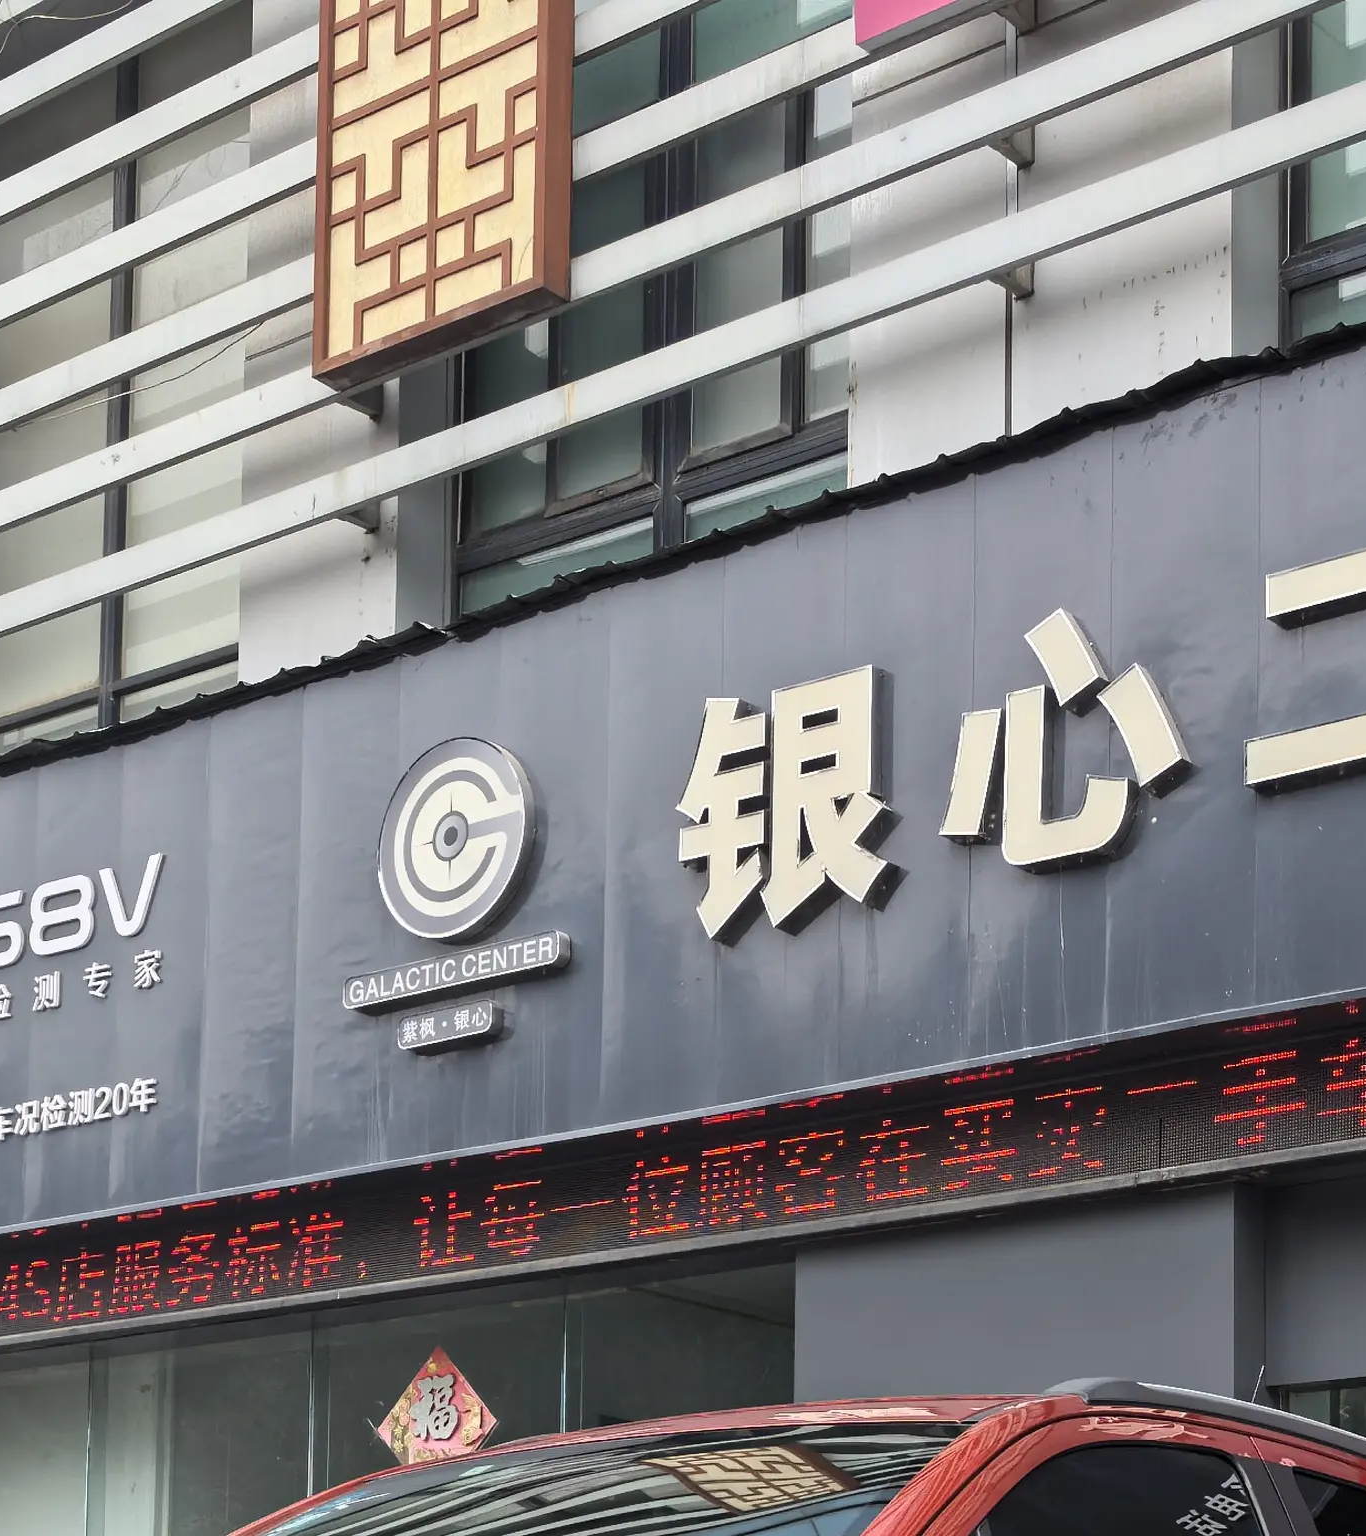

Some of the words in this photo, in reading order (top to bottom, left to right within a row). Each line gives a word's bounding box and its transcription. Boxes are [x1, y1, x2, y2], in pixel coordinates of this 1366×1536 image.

[349, 959, 456, 1004] GALACTIC
[463, 936, 554, 976] CENTER
[408, 1374, 459, 1441] 福
